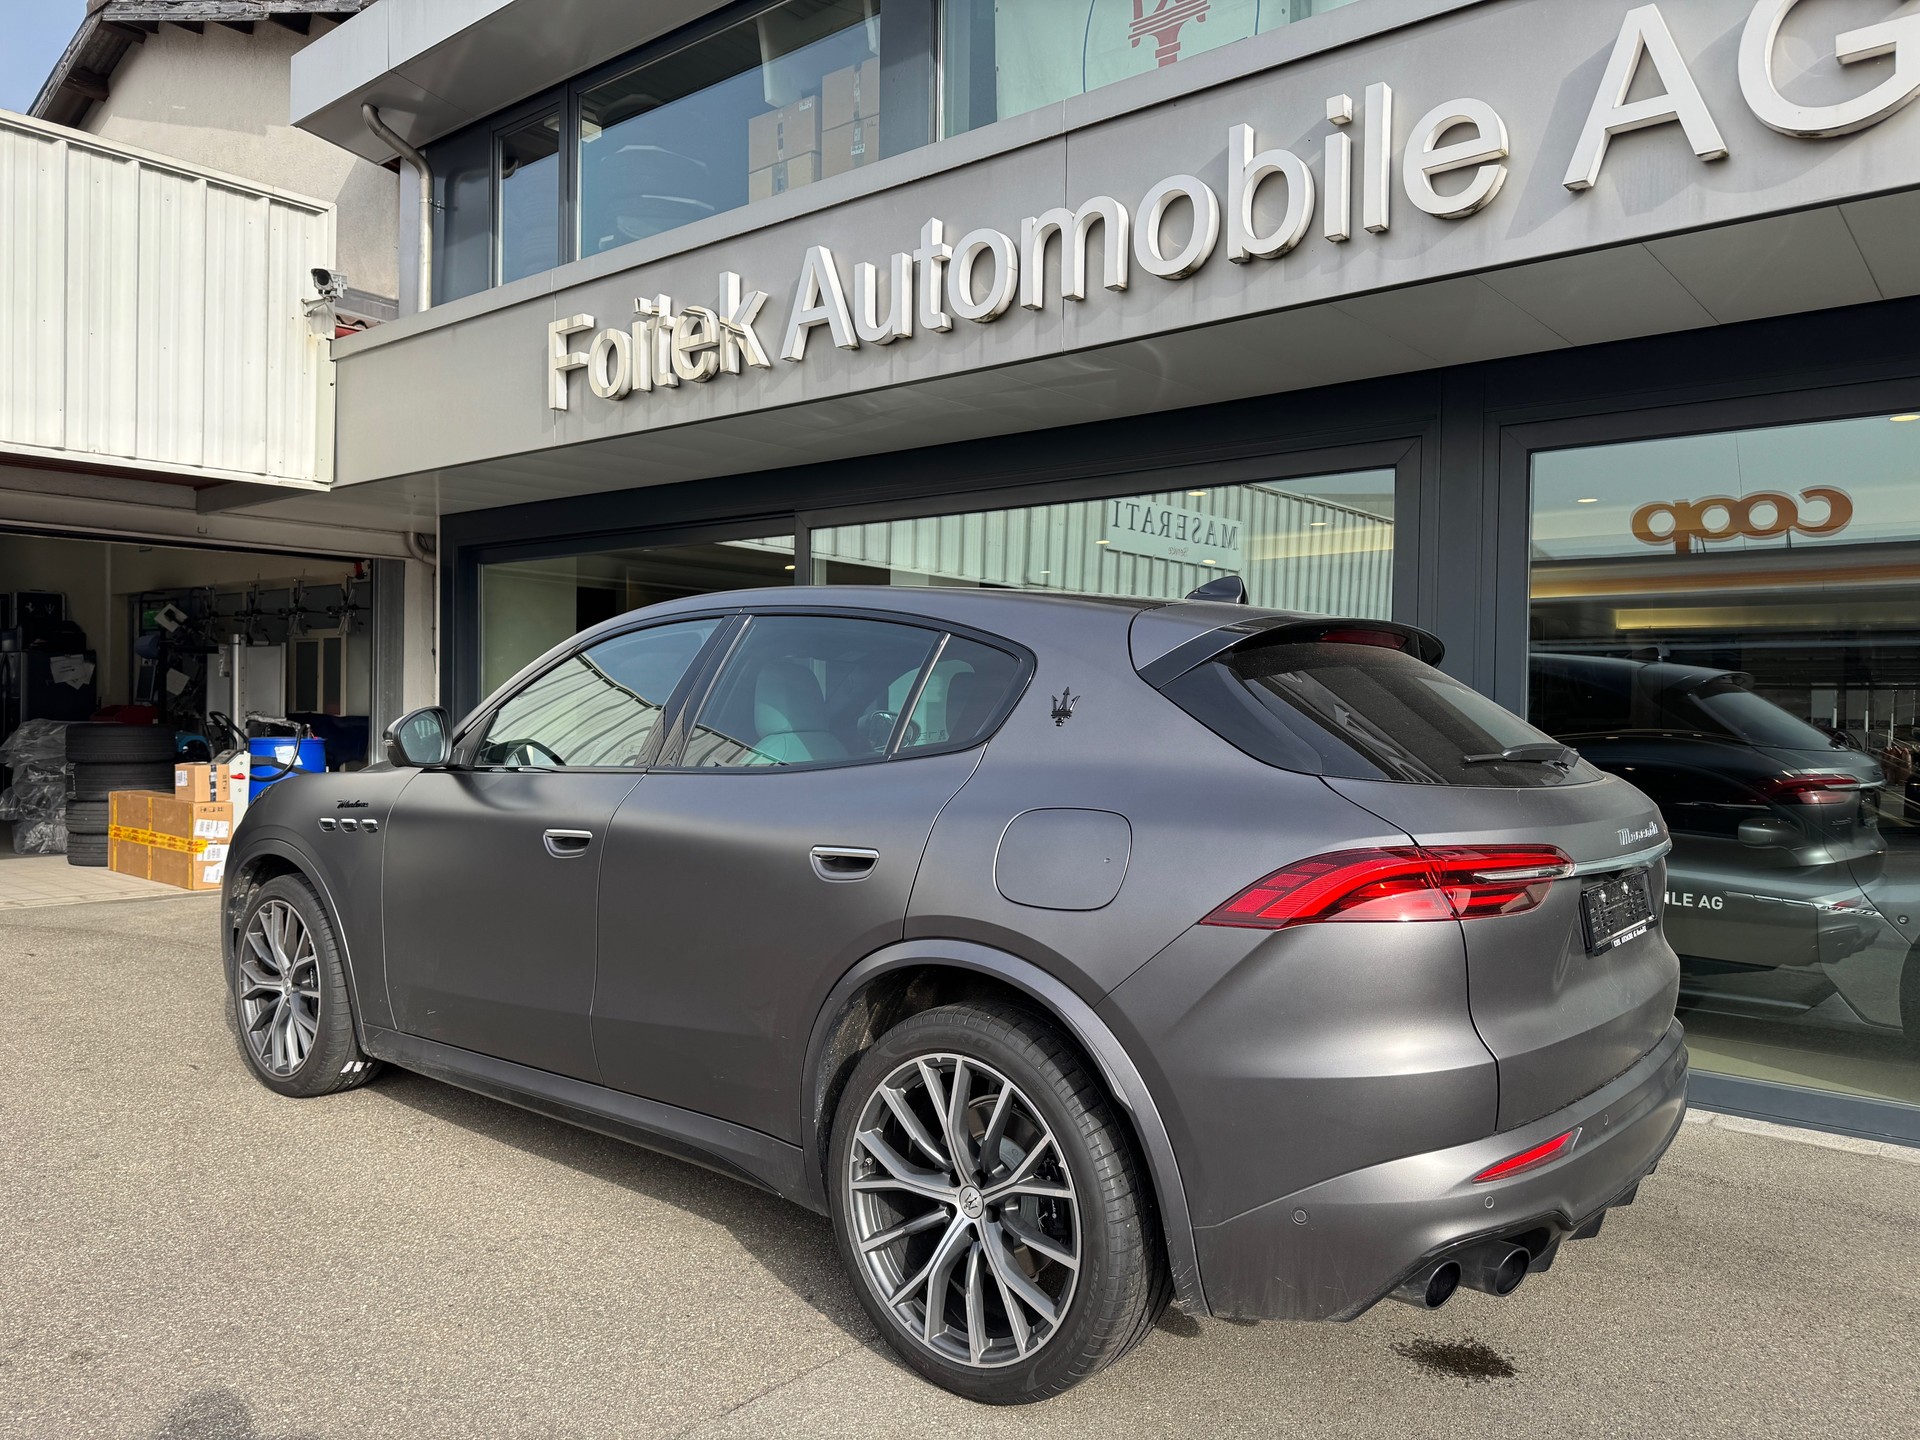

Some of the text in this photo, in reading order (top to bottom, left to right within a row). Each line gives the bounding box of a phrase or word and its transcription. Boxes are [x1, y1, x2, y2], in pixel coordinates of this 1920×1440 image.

[548, 0, 1920, 411] Foitek Automobile AG
[1697, 894, 1724, 911] AG
